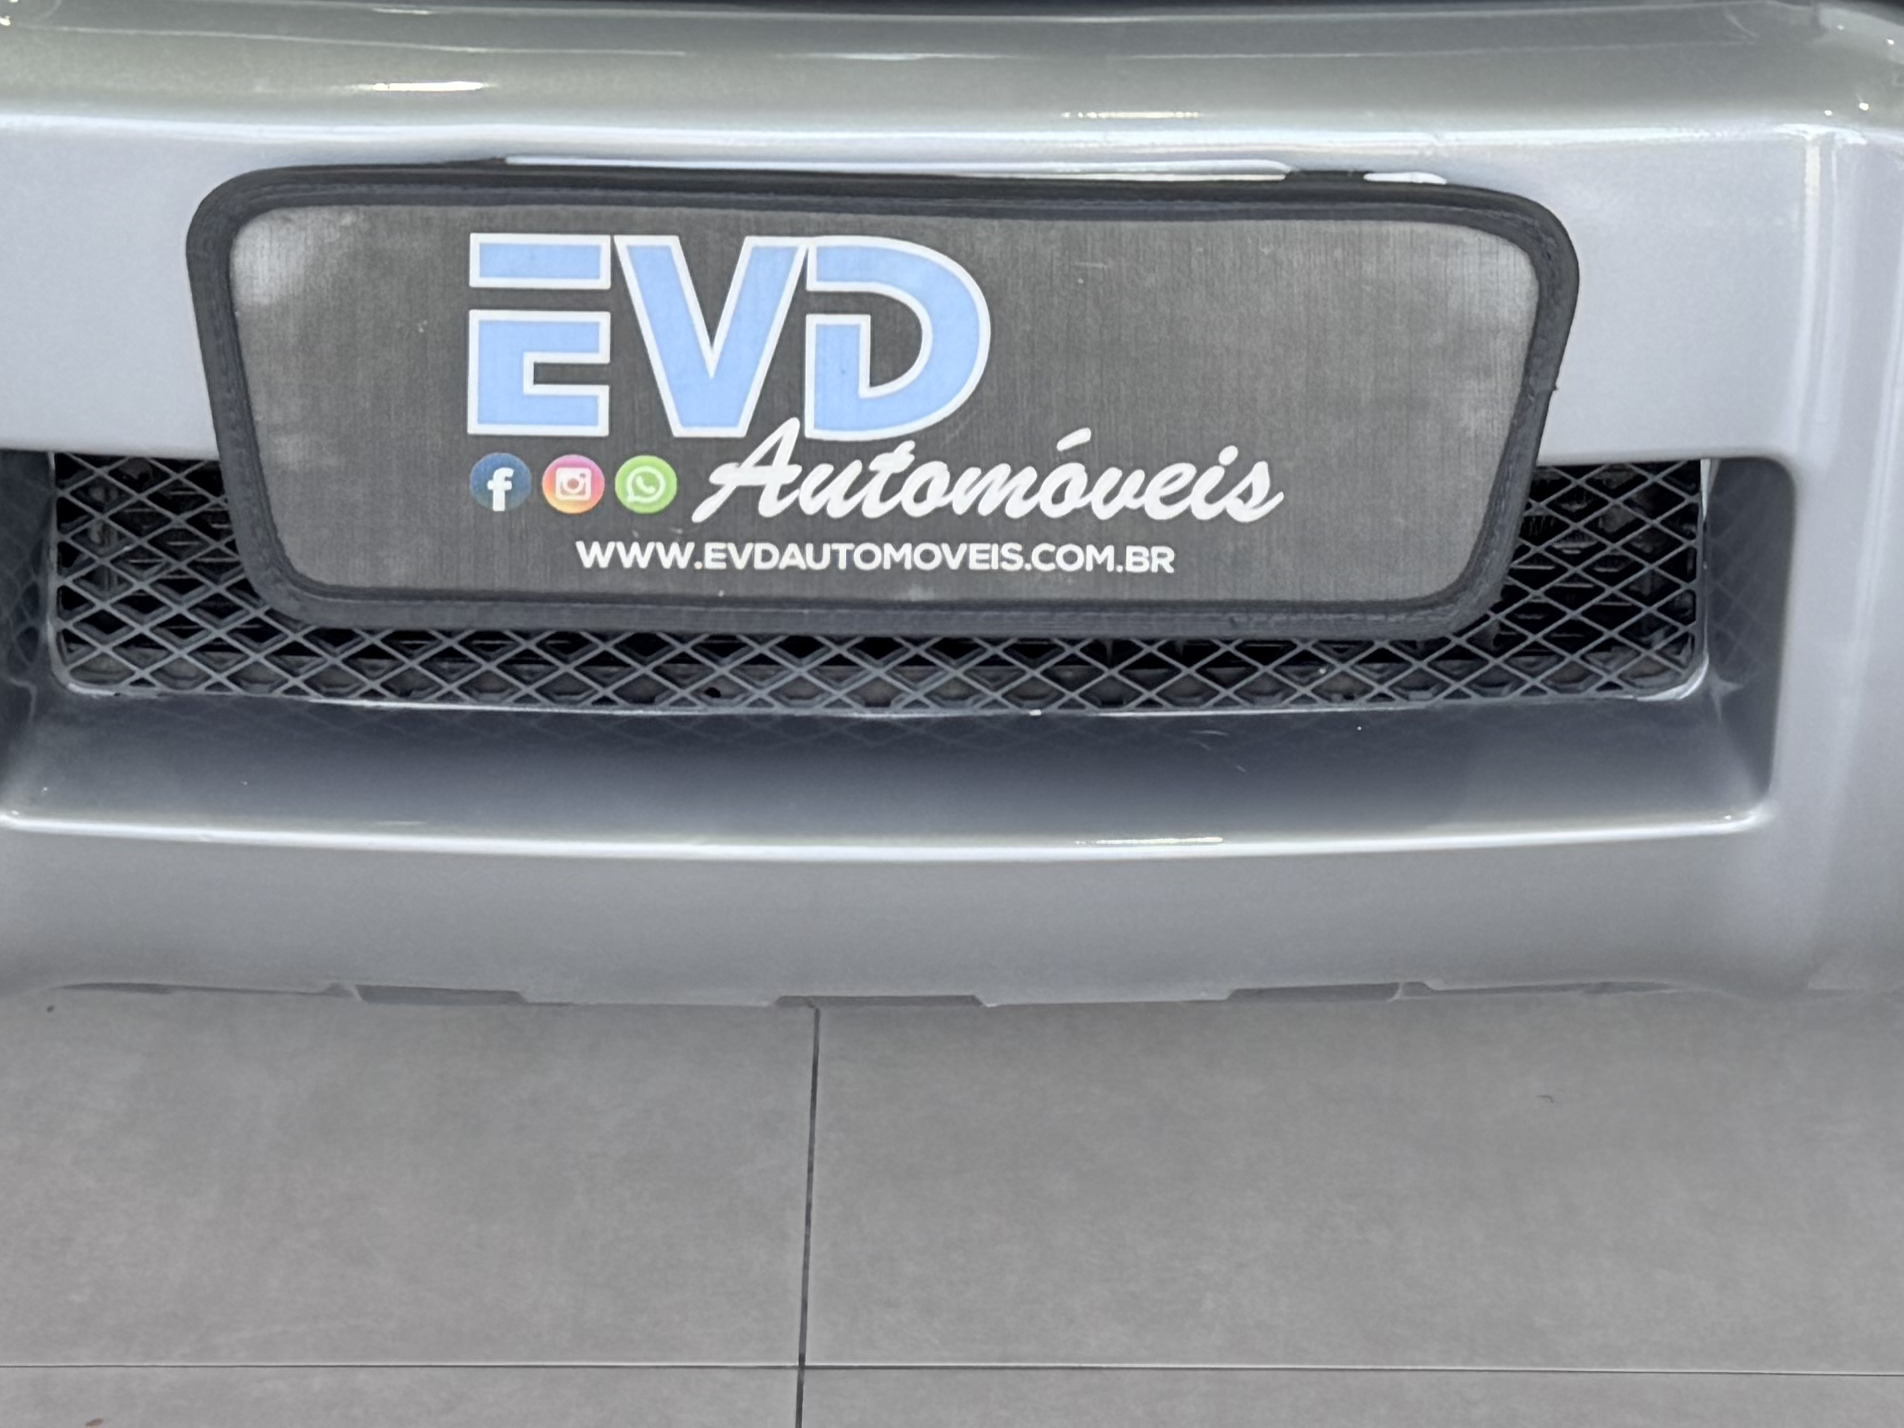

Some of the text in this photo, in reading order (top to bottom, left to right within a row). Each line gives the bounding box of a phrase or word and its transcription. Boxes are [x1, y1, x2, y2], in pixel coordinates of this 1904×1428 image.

[466, 231, 991, 442] EVD
[691, 416, 1285, 524] Automóveis
[575, 539, 1176, 574] WWW.EVDAUTOMOVEIS.COM.BR
